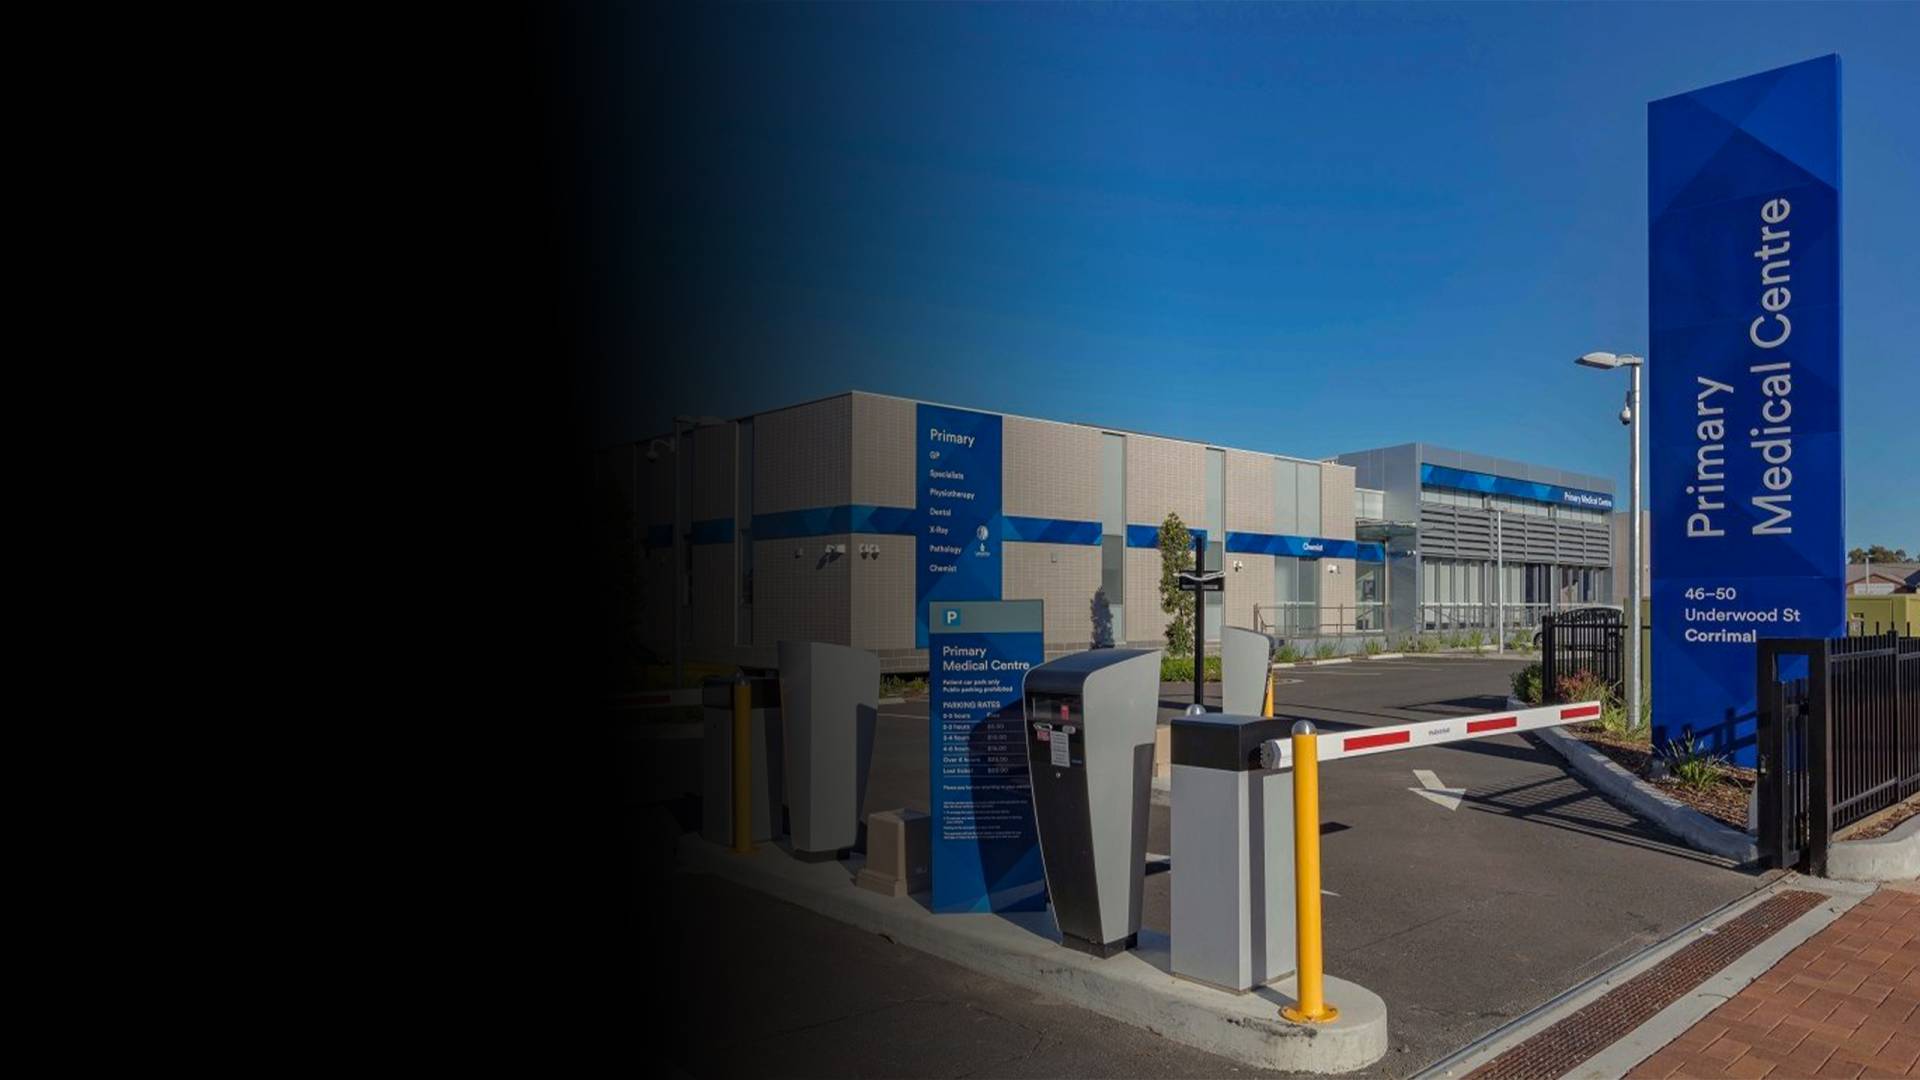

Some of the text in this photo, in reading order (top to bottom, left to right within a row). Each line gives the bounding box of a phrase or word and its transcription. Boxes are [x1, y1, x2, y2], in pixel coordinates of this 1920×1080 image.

[1750, 197, 1793, 535] Medical Centre
[930, 428, 975, 448] Primary
[929, 451, 940, 460] GP
[1686, 375, 1734, 538] Primary
[929, 469, 964, 481] Specialists
[929, 488, 975, 501] Physiotherapy
[929, 507, 951, 517] Dental
[929, 526, 948, 536] X-Ray
[929, 545, 962, 555] Pathology
[929, 564, 957, 574] Chemist
[946, 610, 958, 624] P
[1684, 607, 1801, 622] Underwood St
[1684, 628, 1757, 644] Corrimal
[943, 646, 987, 659] Primary
[943, 660, 1030, 672] Medical Centre
[977, 700, 1001, 709] RATES
